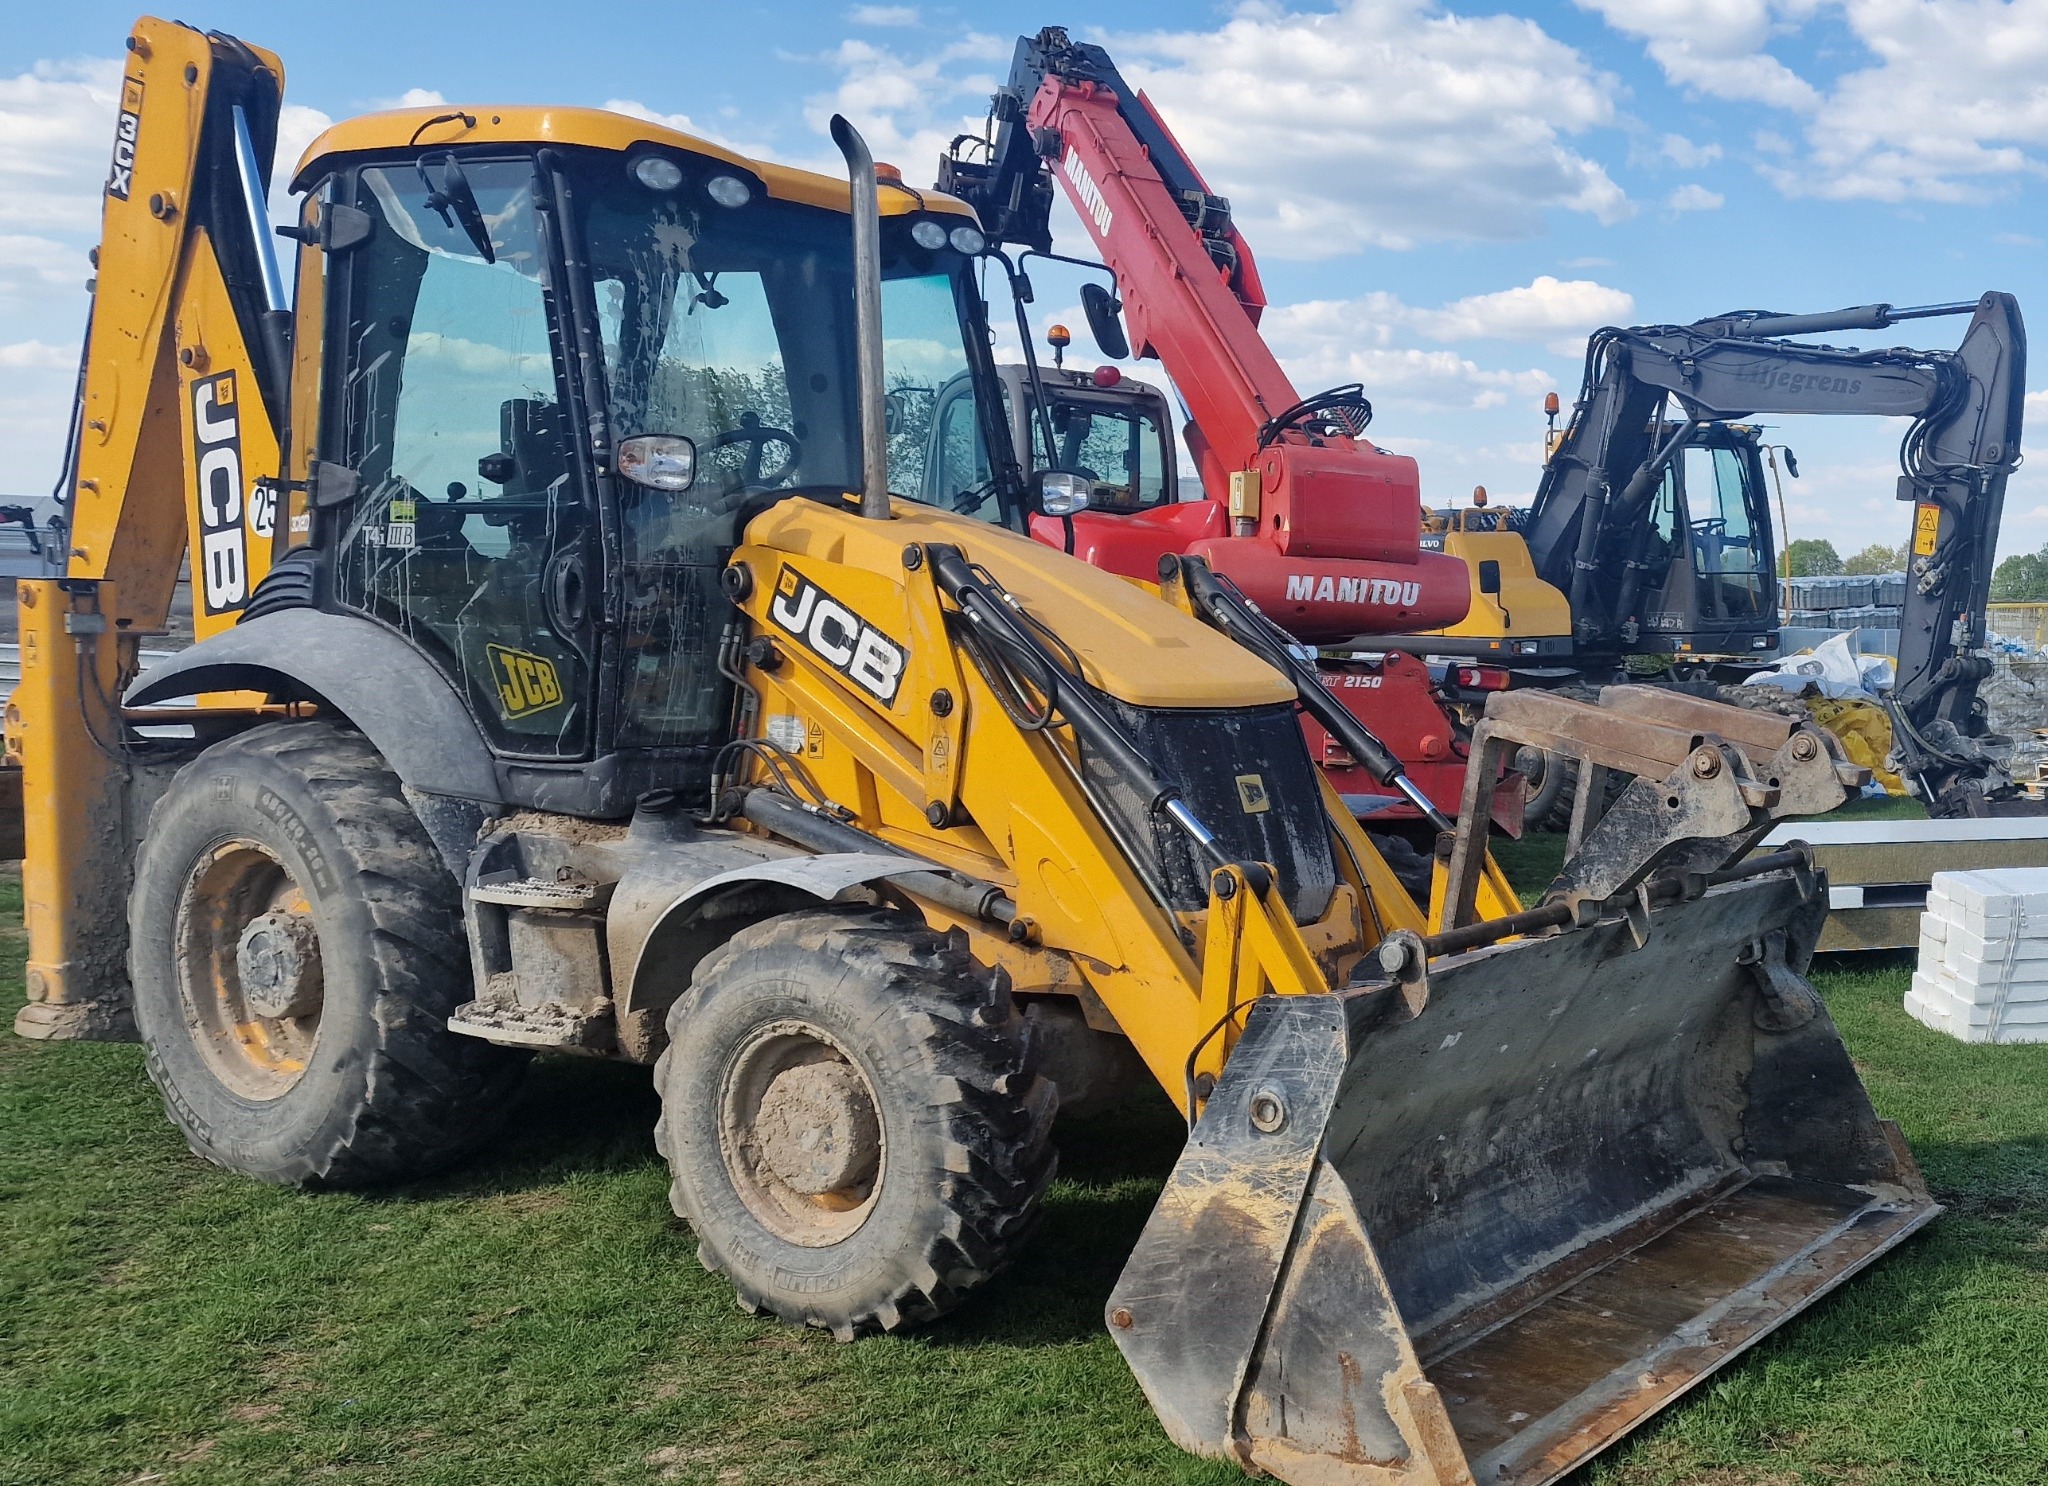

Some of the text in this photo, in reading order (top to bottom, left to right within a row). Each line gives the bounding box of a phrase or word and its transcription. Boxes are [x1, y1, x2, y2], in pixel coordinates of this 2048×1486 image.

[109, 112, 139, 197] 3CX
[1063, 144, 1113, 237] MANITOU
[1734, 362, 1863, 394] Liljegrens
[195, 382, 245, 609] JCB
[255, 488, 276, 531] 25
[1285, 574, 1421, 607] MANITOU
[772, 584, 902, 699] JCB
[499, 652, 557, 711] JCB
[1343, 674, 1383, 689] 2150
